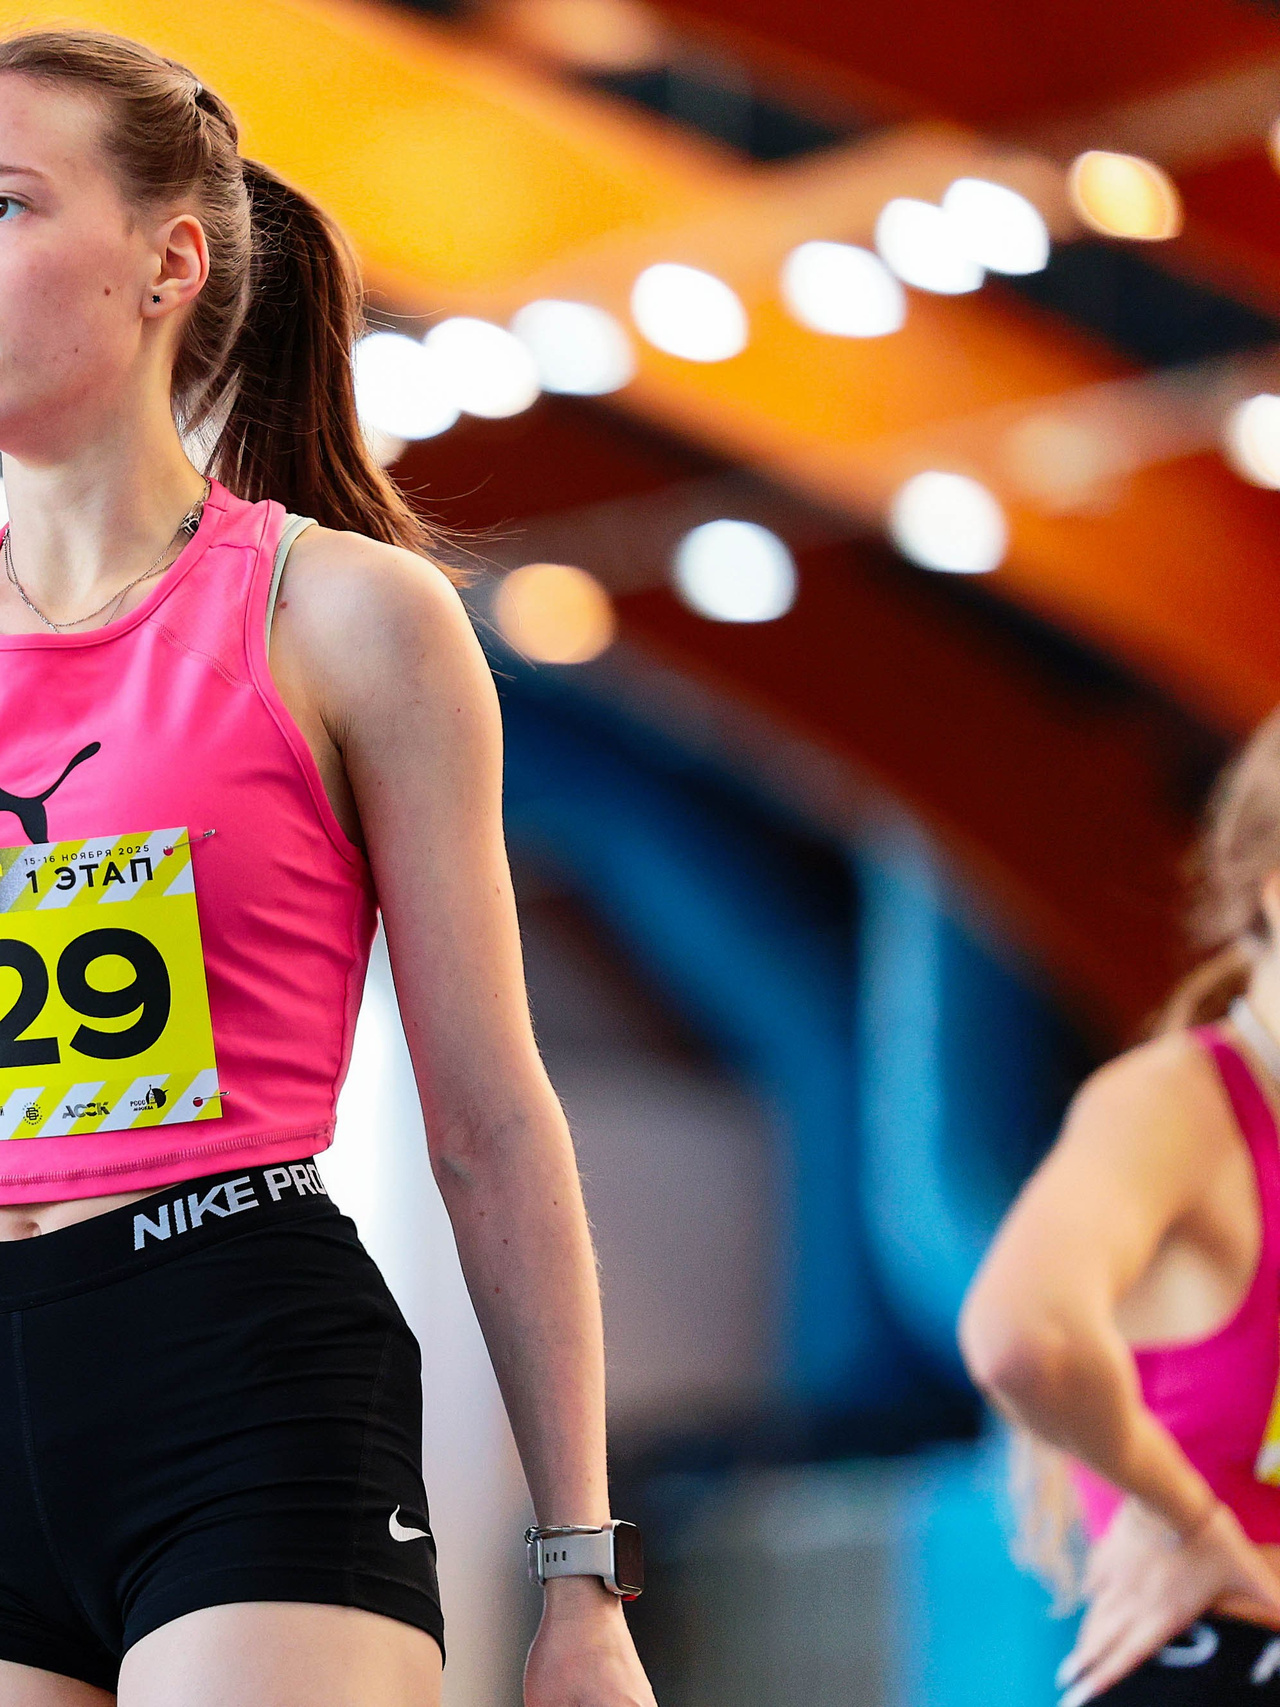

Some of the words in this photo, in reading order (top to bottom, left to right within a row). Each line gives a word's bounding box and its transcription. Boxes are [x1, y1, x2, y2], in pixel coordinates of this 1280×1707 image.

[24, 855, 56, 866] 15-16
[61, 849, 112, 862] НОЯБРЯ
[118, 844, 150, 856] 2025
[25, 869, 39, 894] 1
[54, 857, 154, 891] ЭТАП
[133, 1175, 260, 1251] NIKE
[263, 1163, 328, 1202] PRO
